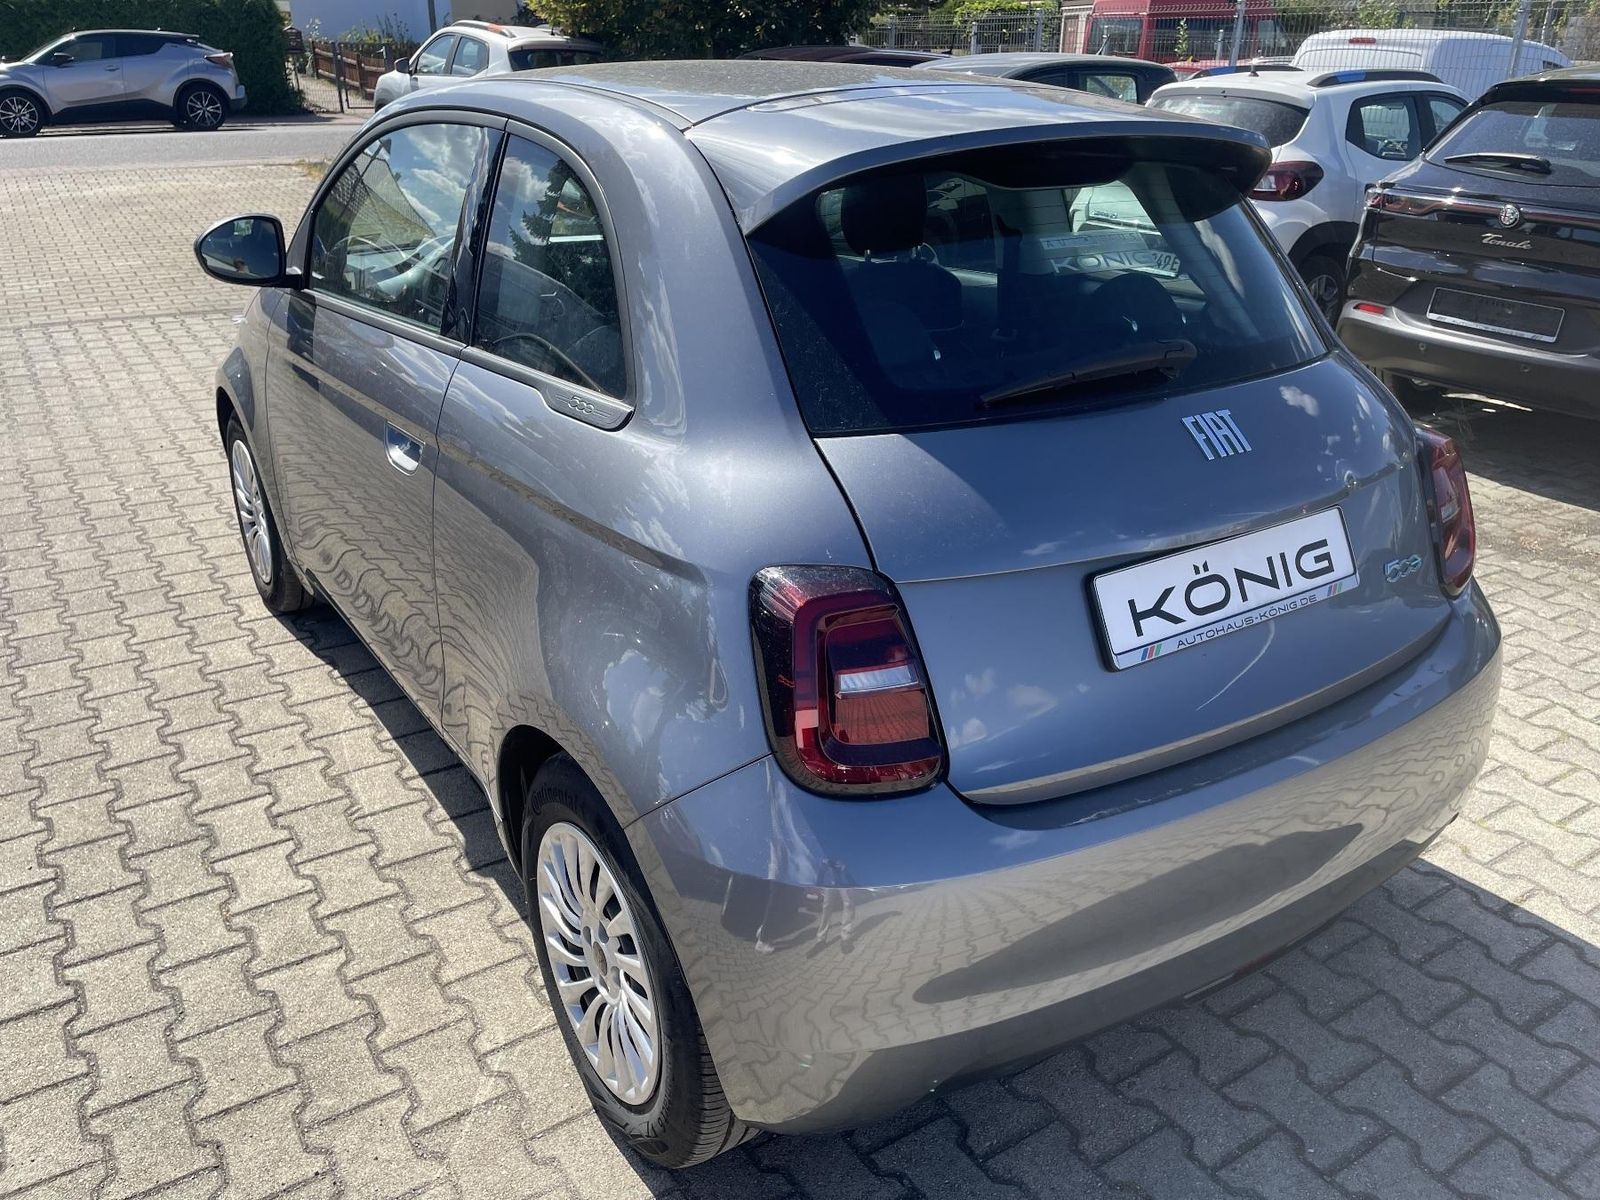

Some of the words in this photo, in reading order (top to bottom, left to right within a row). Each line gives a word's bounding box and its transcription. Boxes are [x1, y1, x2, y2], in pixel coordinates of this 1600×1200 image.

[1481, 233, 1532, 249] Tonale
[1181, 409, 1252, 461] FIAT
[1127, 538, 1335, 637] KÖNIG
